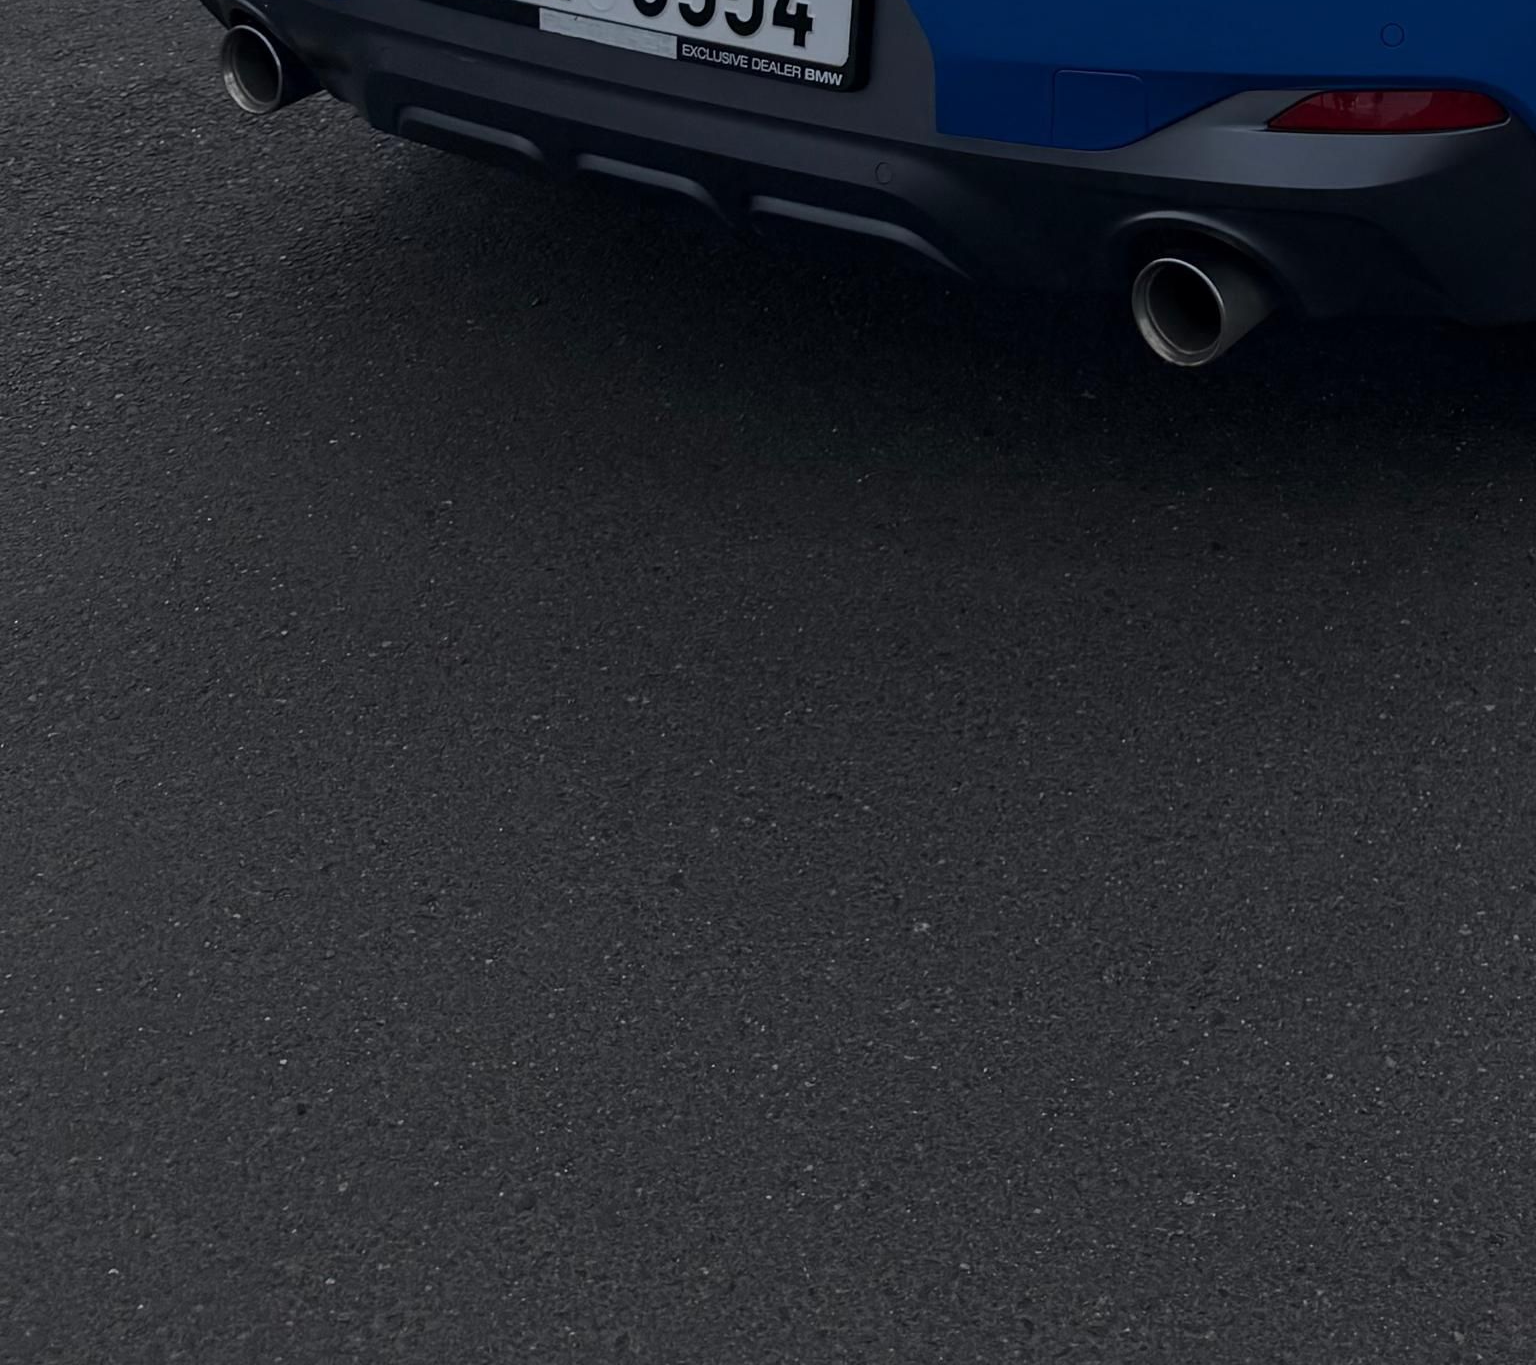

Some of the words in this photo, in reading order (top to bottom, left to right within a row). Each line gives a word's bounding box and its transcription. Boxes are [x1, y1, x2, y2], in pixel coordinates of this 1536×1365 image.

[682, 43, 748, 68] EXCLUSIVE
[751, 57, 801, 79] DEALER
[804, 68, 843, 86] BMW
